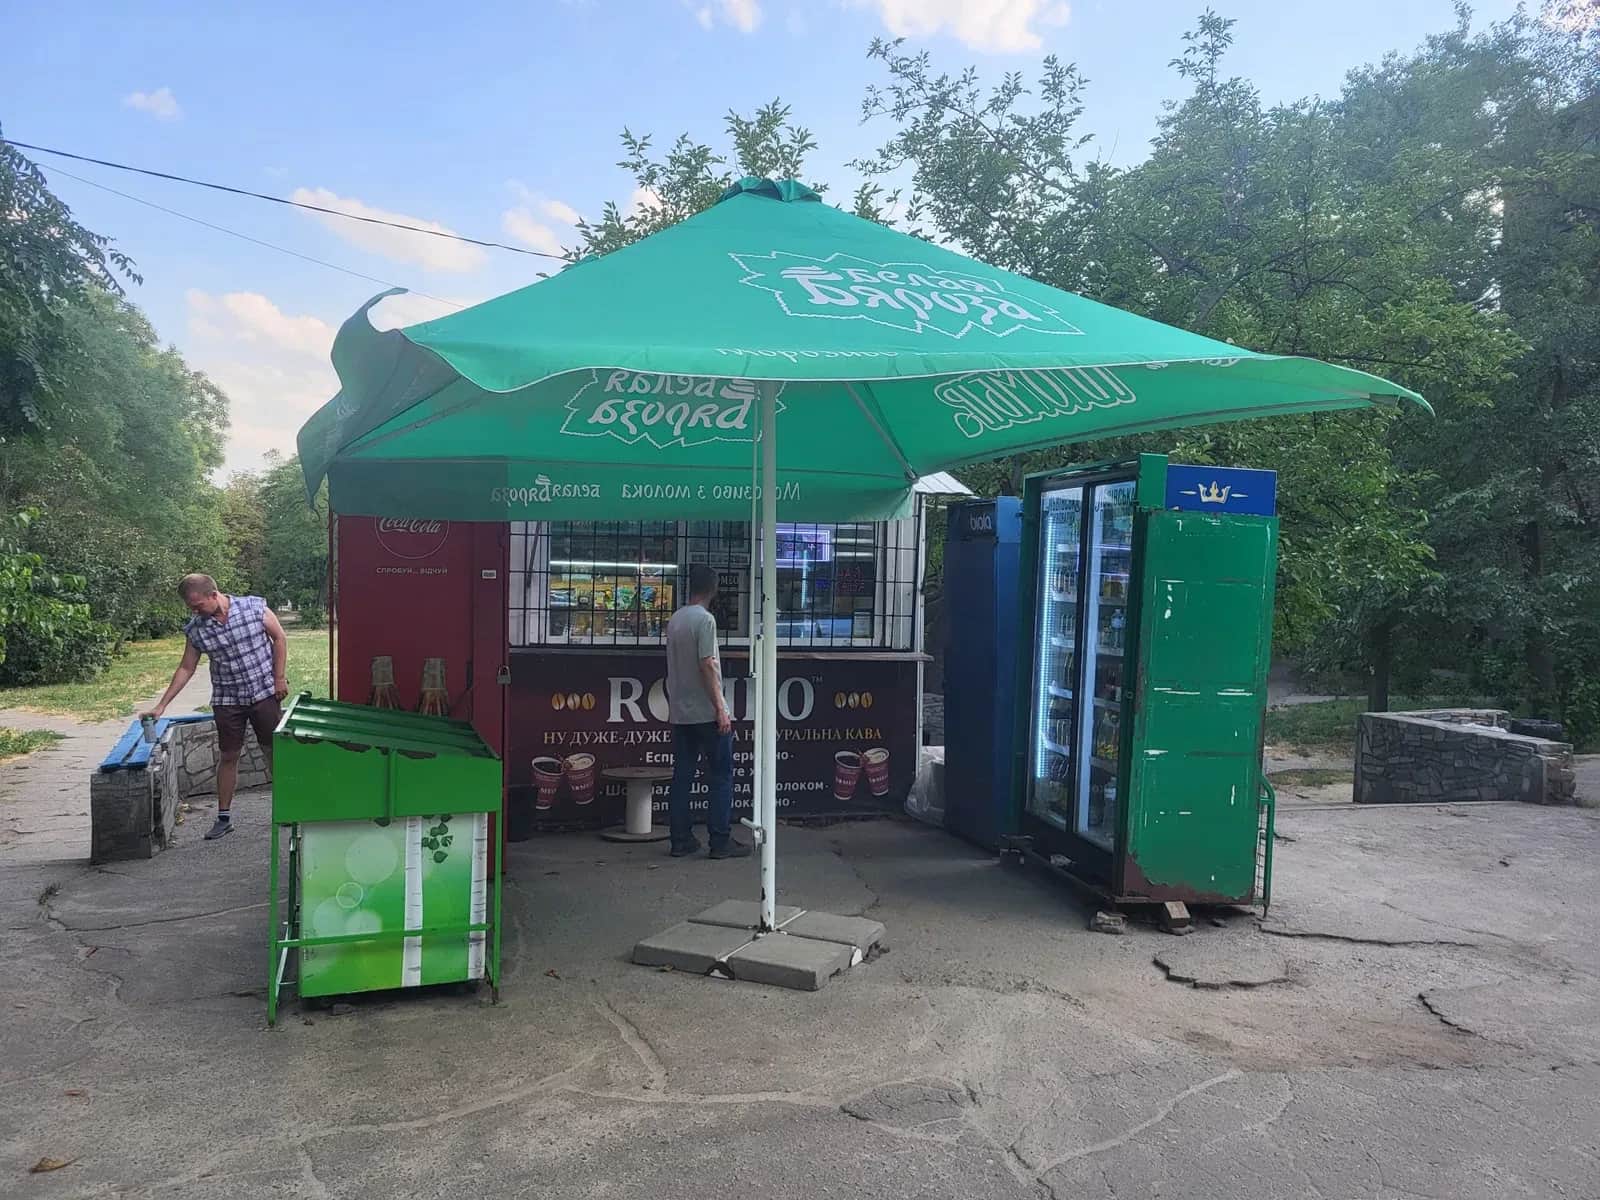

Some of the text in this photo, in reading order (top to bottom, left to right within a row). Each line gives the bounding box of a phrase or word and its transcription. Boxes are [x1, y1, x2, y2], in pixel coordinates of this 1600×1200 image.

[543, 731, 567, 746] НУ
[569, 730, 672, 747] ДУЖЕ-ДУЖЕ
[744, 728, 842, 742] НУРАЛЬНА
[845, 727, 882, 741] КАВА
[776, 781, 824, 791] олоком
